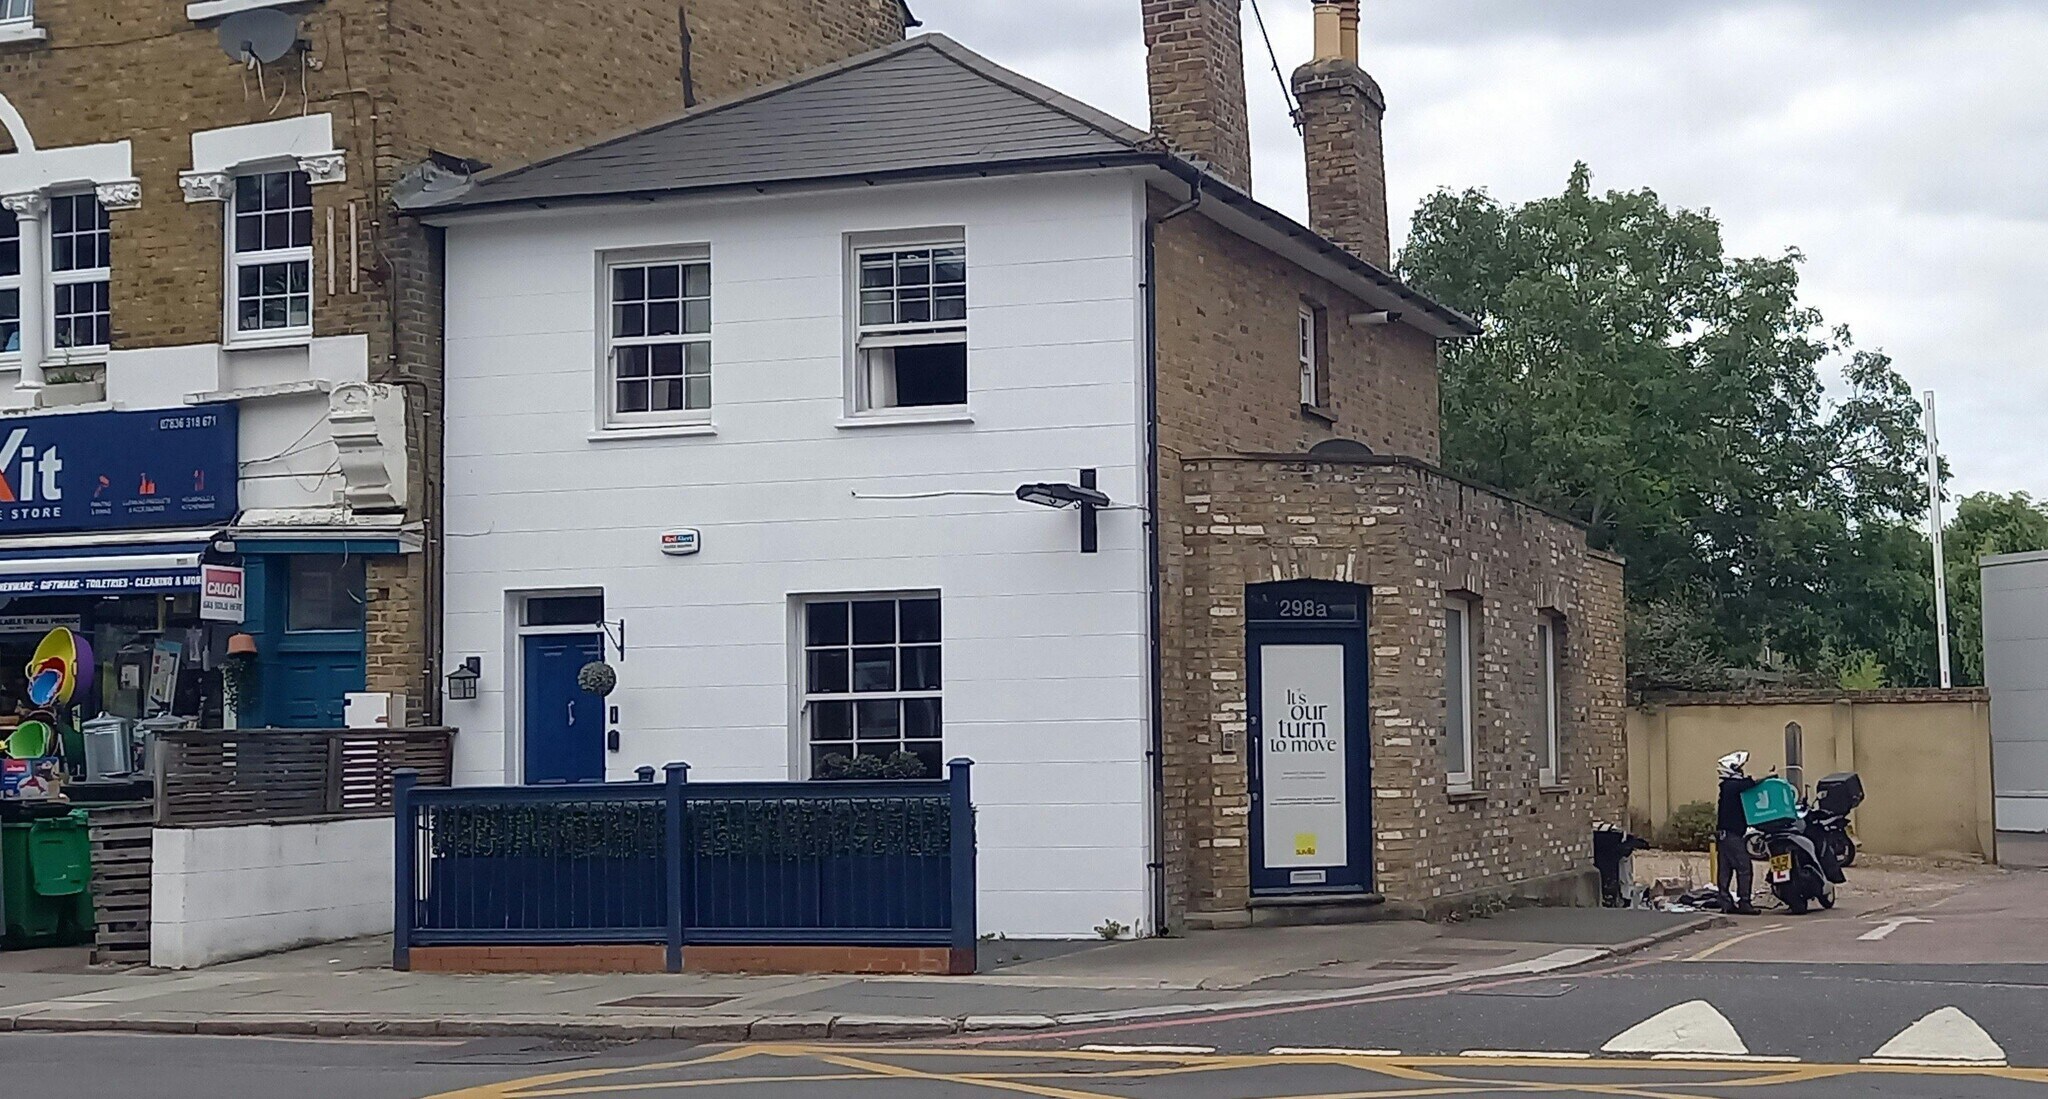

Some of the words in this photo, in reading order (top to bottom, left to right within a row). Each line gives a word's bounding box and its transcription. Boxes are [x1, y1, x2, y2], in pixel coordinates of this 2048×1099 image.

[12, 507, 61, 519] STORE
[207, 582, 240, 598] CALOR
[1280, 599, 1328, 617] 298a
[1287, 688, 1307, 705] It's
[1291, 705, 1328, 720] our
[1278, 719, 1326, 738] turn
[1270, 738, 1286, 752] to
[1291, 739, 1337, 752] move
[1777, 871, 1786, 879] L
